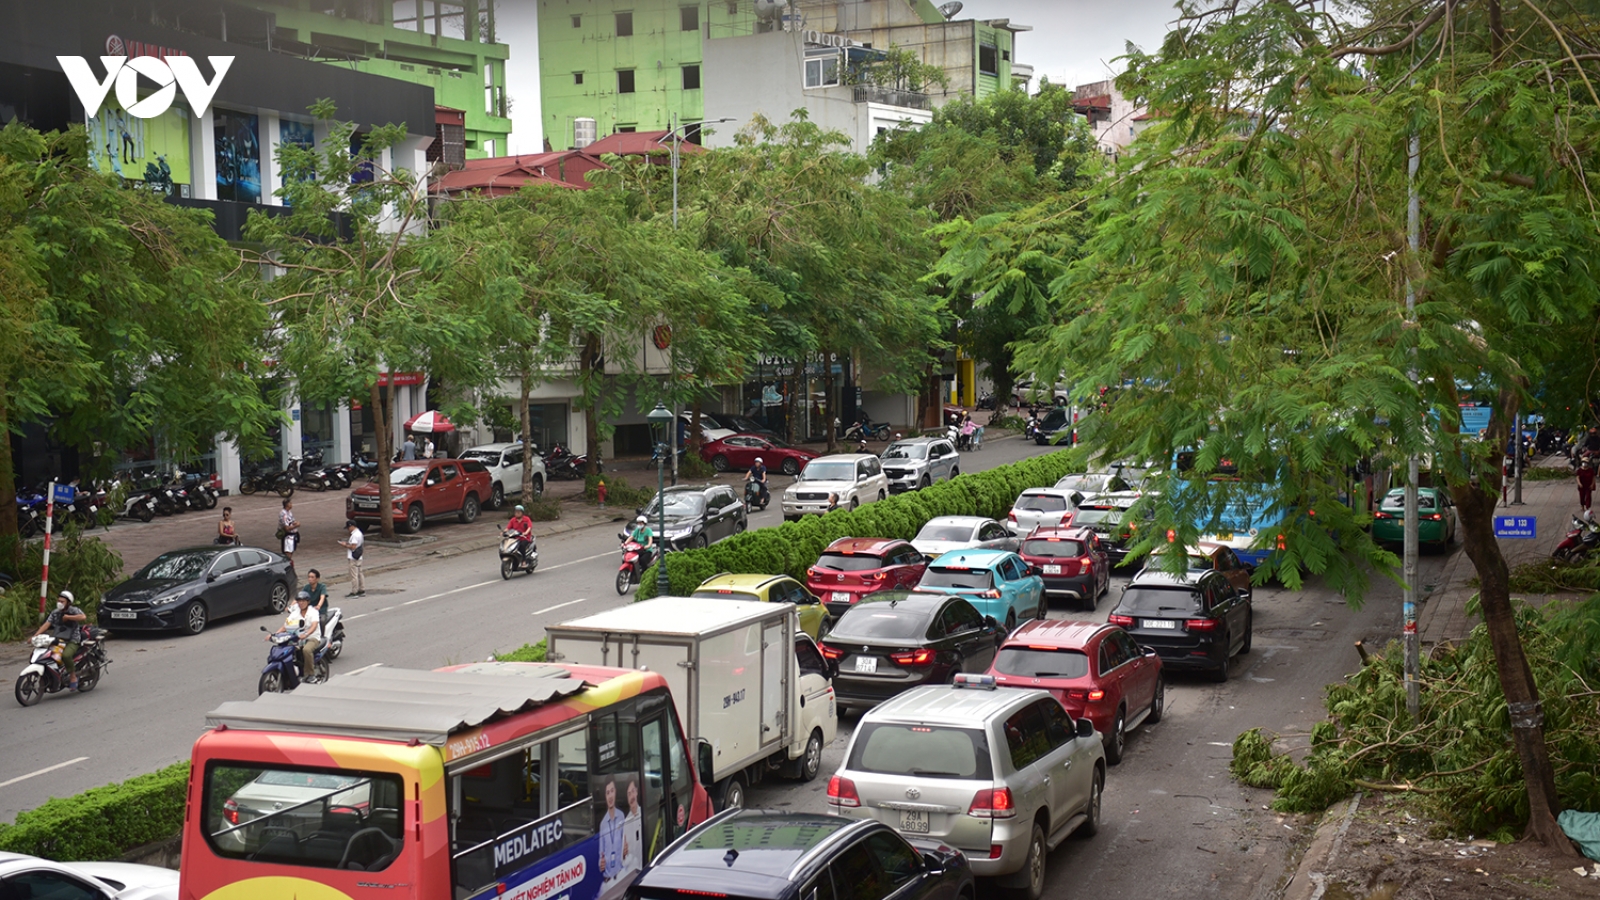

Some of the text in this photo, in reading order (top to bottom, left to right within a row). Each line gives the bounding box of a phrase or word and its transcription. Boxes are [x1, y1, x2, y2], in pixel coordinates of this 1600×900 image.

[906, 810, 922, 821] 29A
[494, 819, 563, 869] MEDLATEC
[526, 876, 555, 900] NGHIỆM
[555, 869, 571, 889] TẬN
[571, 861, 584, 880] NƠI
